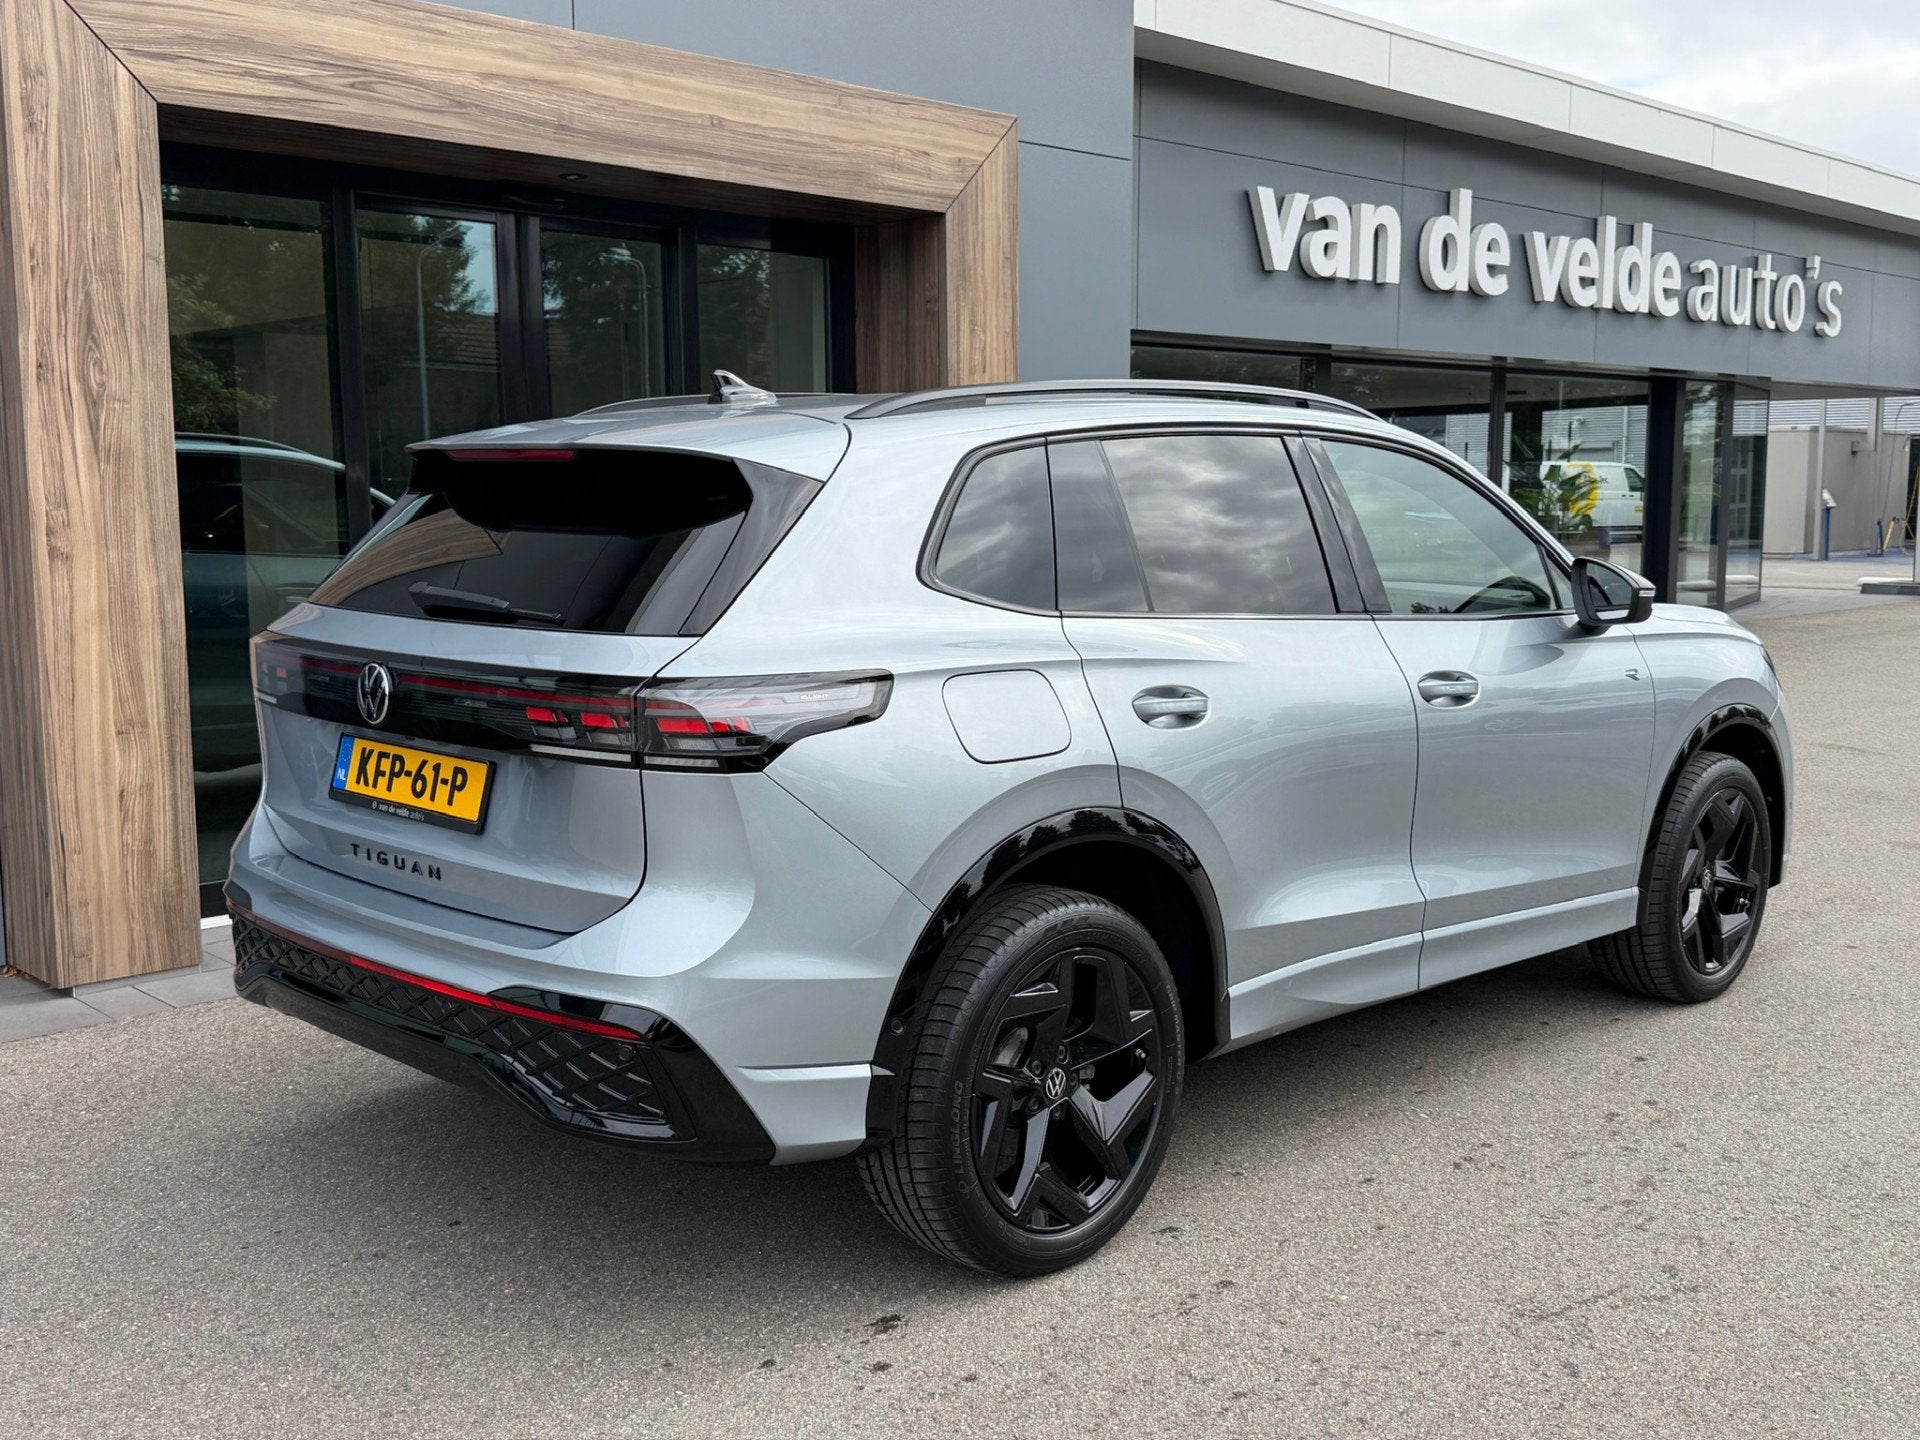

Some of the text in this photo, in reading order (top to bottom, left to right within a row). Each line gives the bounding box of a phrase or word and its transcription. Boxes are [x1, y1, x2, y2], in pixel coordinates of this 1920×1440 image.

[1246, 186, 1843, 338] van de velde auto's
[336, 767, 346, 781] NL
[355, 746, 469, 807] KFP-61-P
[350, 843, 442, 881] TIGUAN
